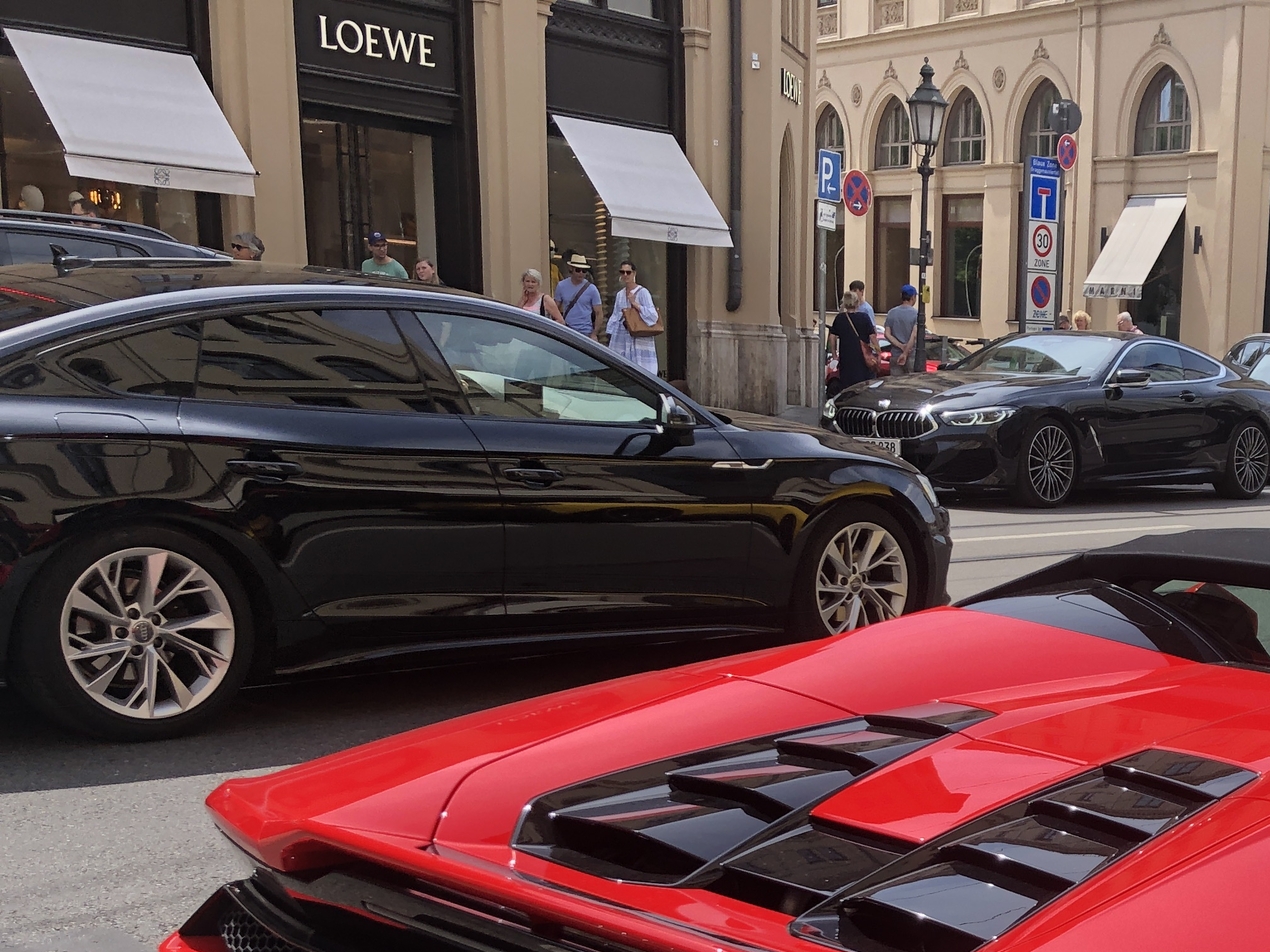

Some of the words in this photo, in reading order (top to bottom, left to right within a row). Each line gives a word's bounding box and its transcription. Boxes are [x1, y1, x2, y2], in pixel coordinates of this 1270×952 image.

[318, 14, 436, 68] LOEWE
[782, 67, 802, 105] LOEWE
[1046, 160, 1058, 168] Zone
[821, 156, 834, 194] P
[1036, 233, 1049, 249] 30
[1034, 258, 1050, 268] ZONE
[1088, 286, 1137, 296] MARNI
[1032, 309, 1048, 319] ZONE
